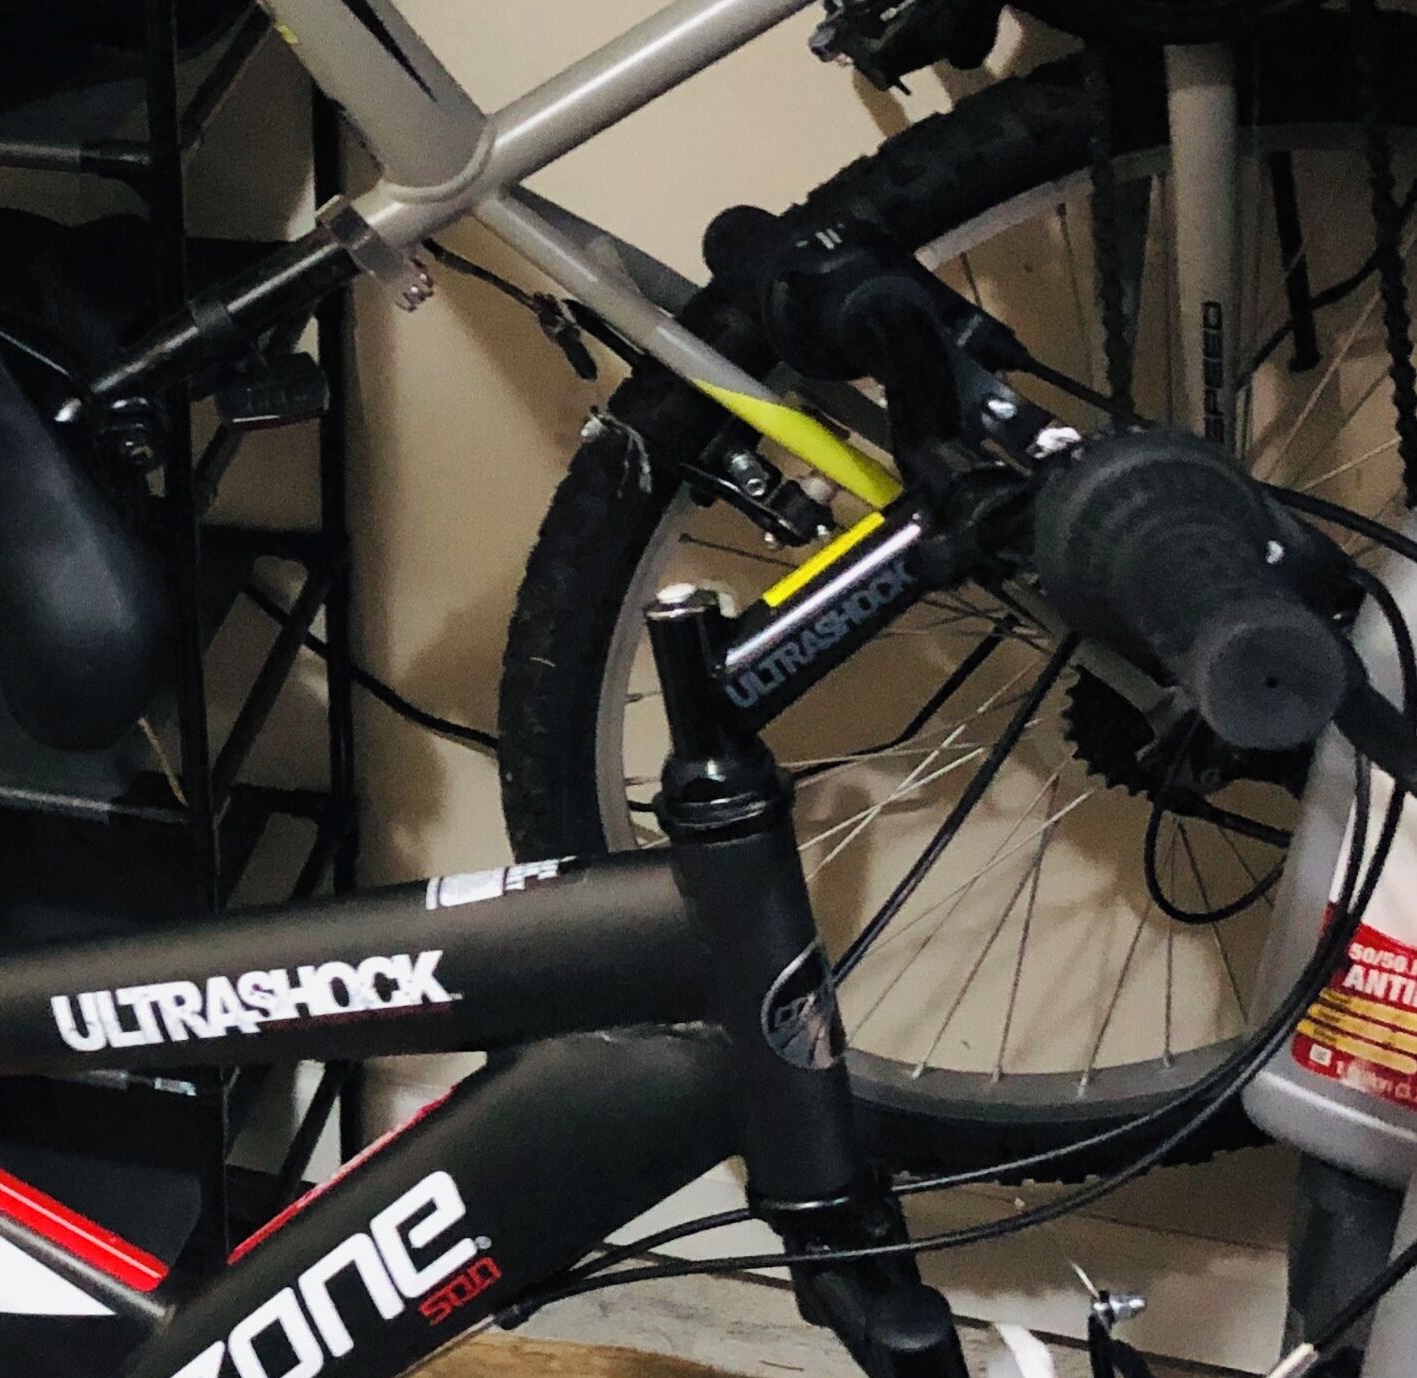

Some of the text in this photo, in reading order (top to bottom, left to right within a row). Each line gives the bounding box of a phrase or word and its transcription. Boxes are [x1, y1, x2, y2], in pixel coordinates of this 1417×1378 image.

[725, 561, 918, 708] ULTRASHOCK
[50, 950, 445, 1052] ULTRASHOCK
[1342, 963, 1417, 1008] ANTI
